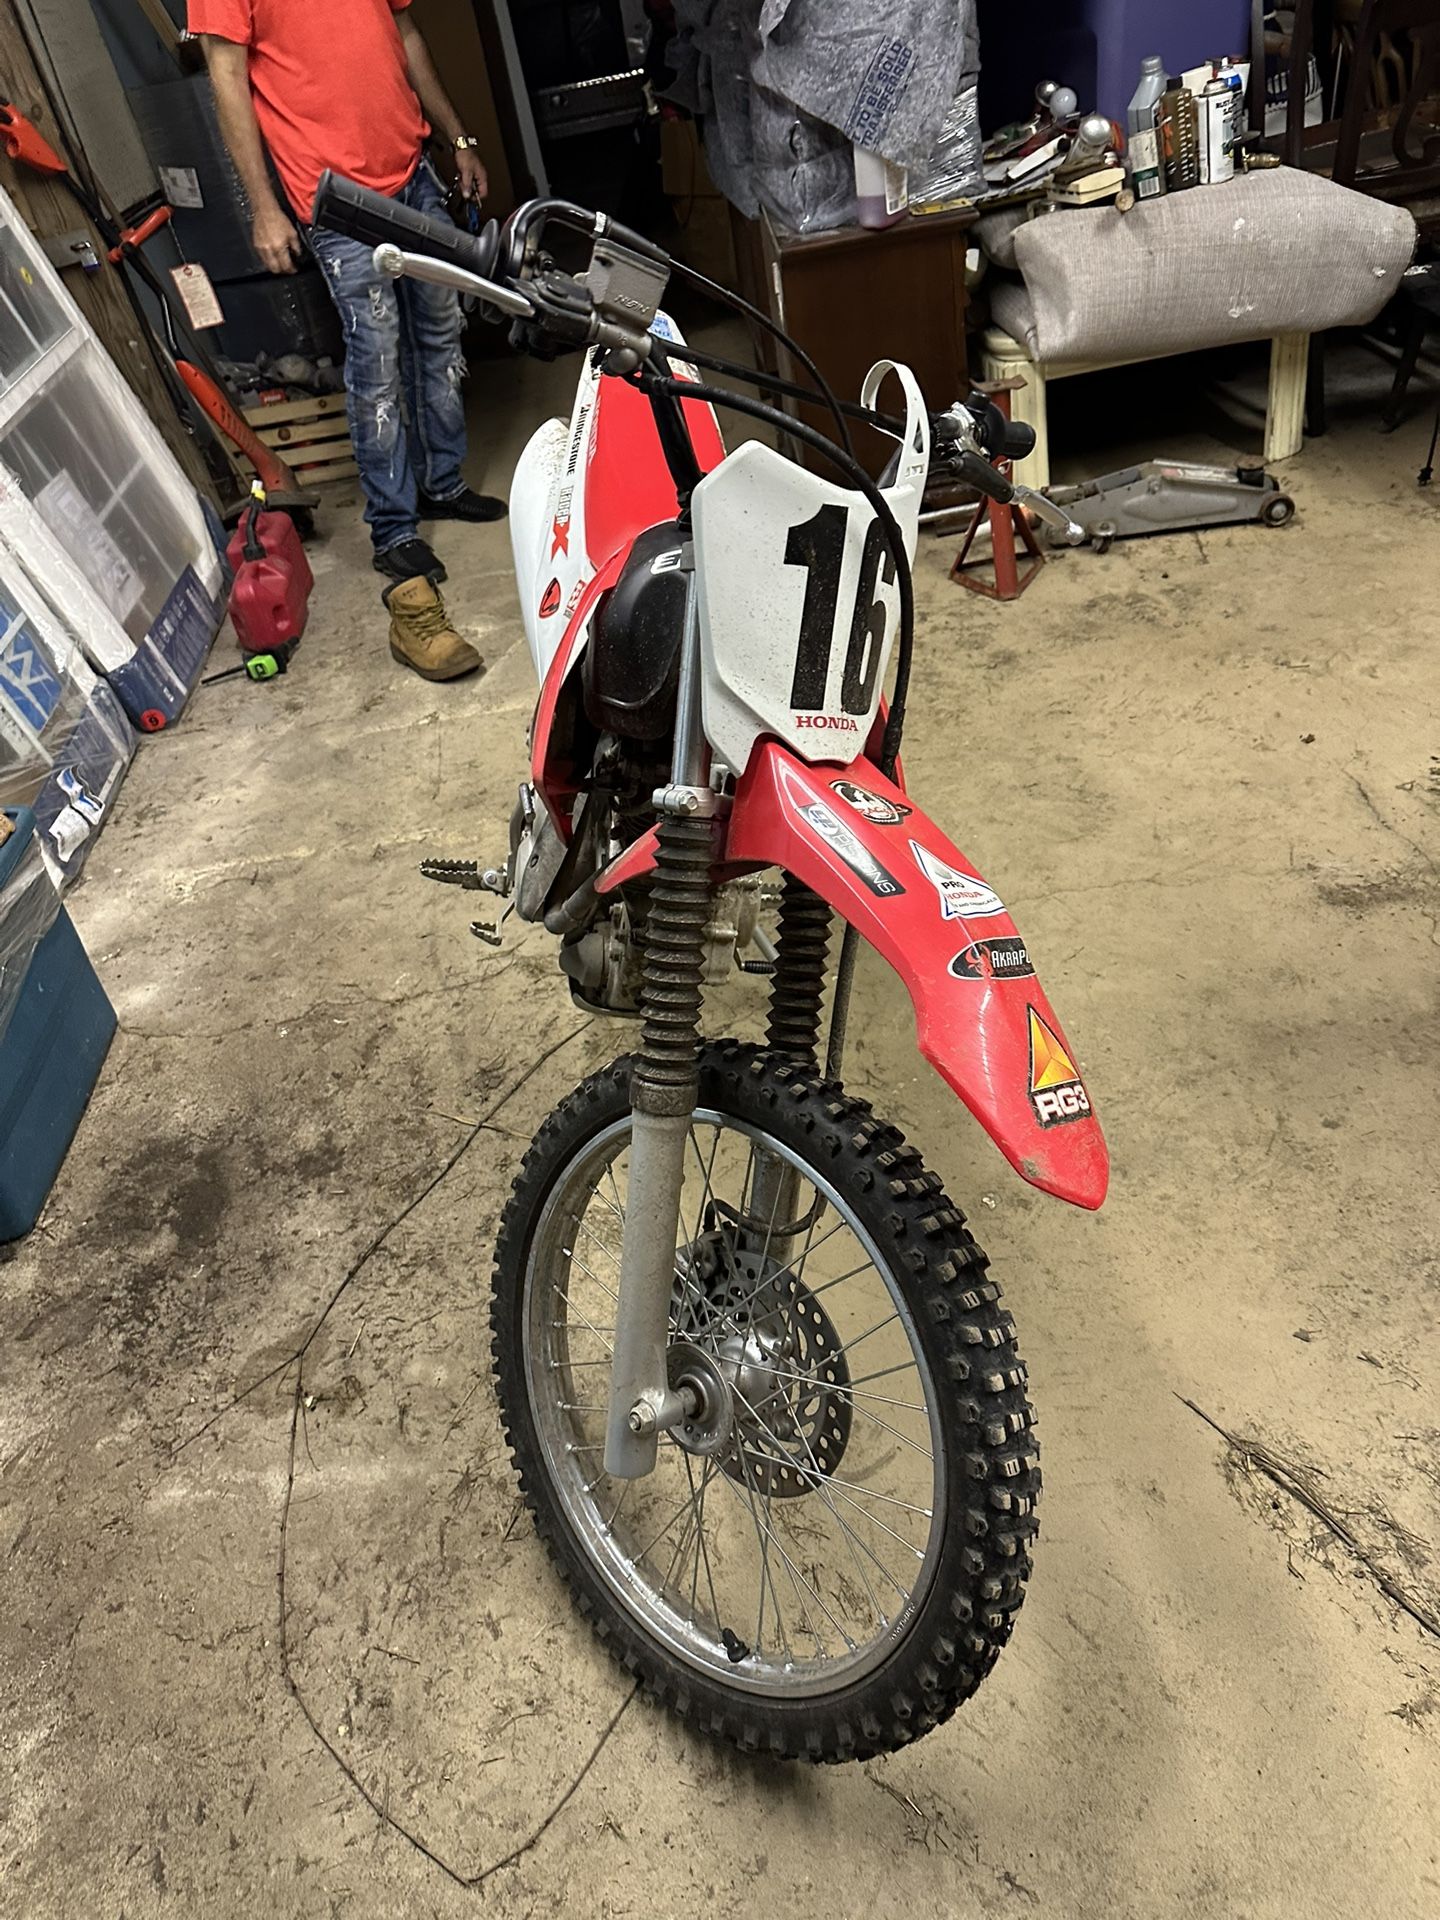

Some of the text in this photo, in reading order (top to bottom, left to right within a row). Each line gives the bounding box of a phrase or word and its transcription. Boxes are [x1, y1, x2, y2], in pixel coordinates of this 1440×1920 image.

[856, 109, 871, 128] TO
[866, 86, 882, 106] BE
[878, 41, 902, 84] SOLD
[860, 47, 912, 146] TRANSFERRED
[567, 404, 590, 476] BRIDGESTONE
[783, 503, 898, 715] 16
[795, 715, 858, 731] HONDA
[830, 833, 897, 894] PISONS
[941, 881, 965, 890] PRO
[944, 891, 984, 900] HONDA
[1034, 1084, 1091, 1123] RG3
